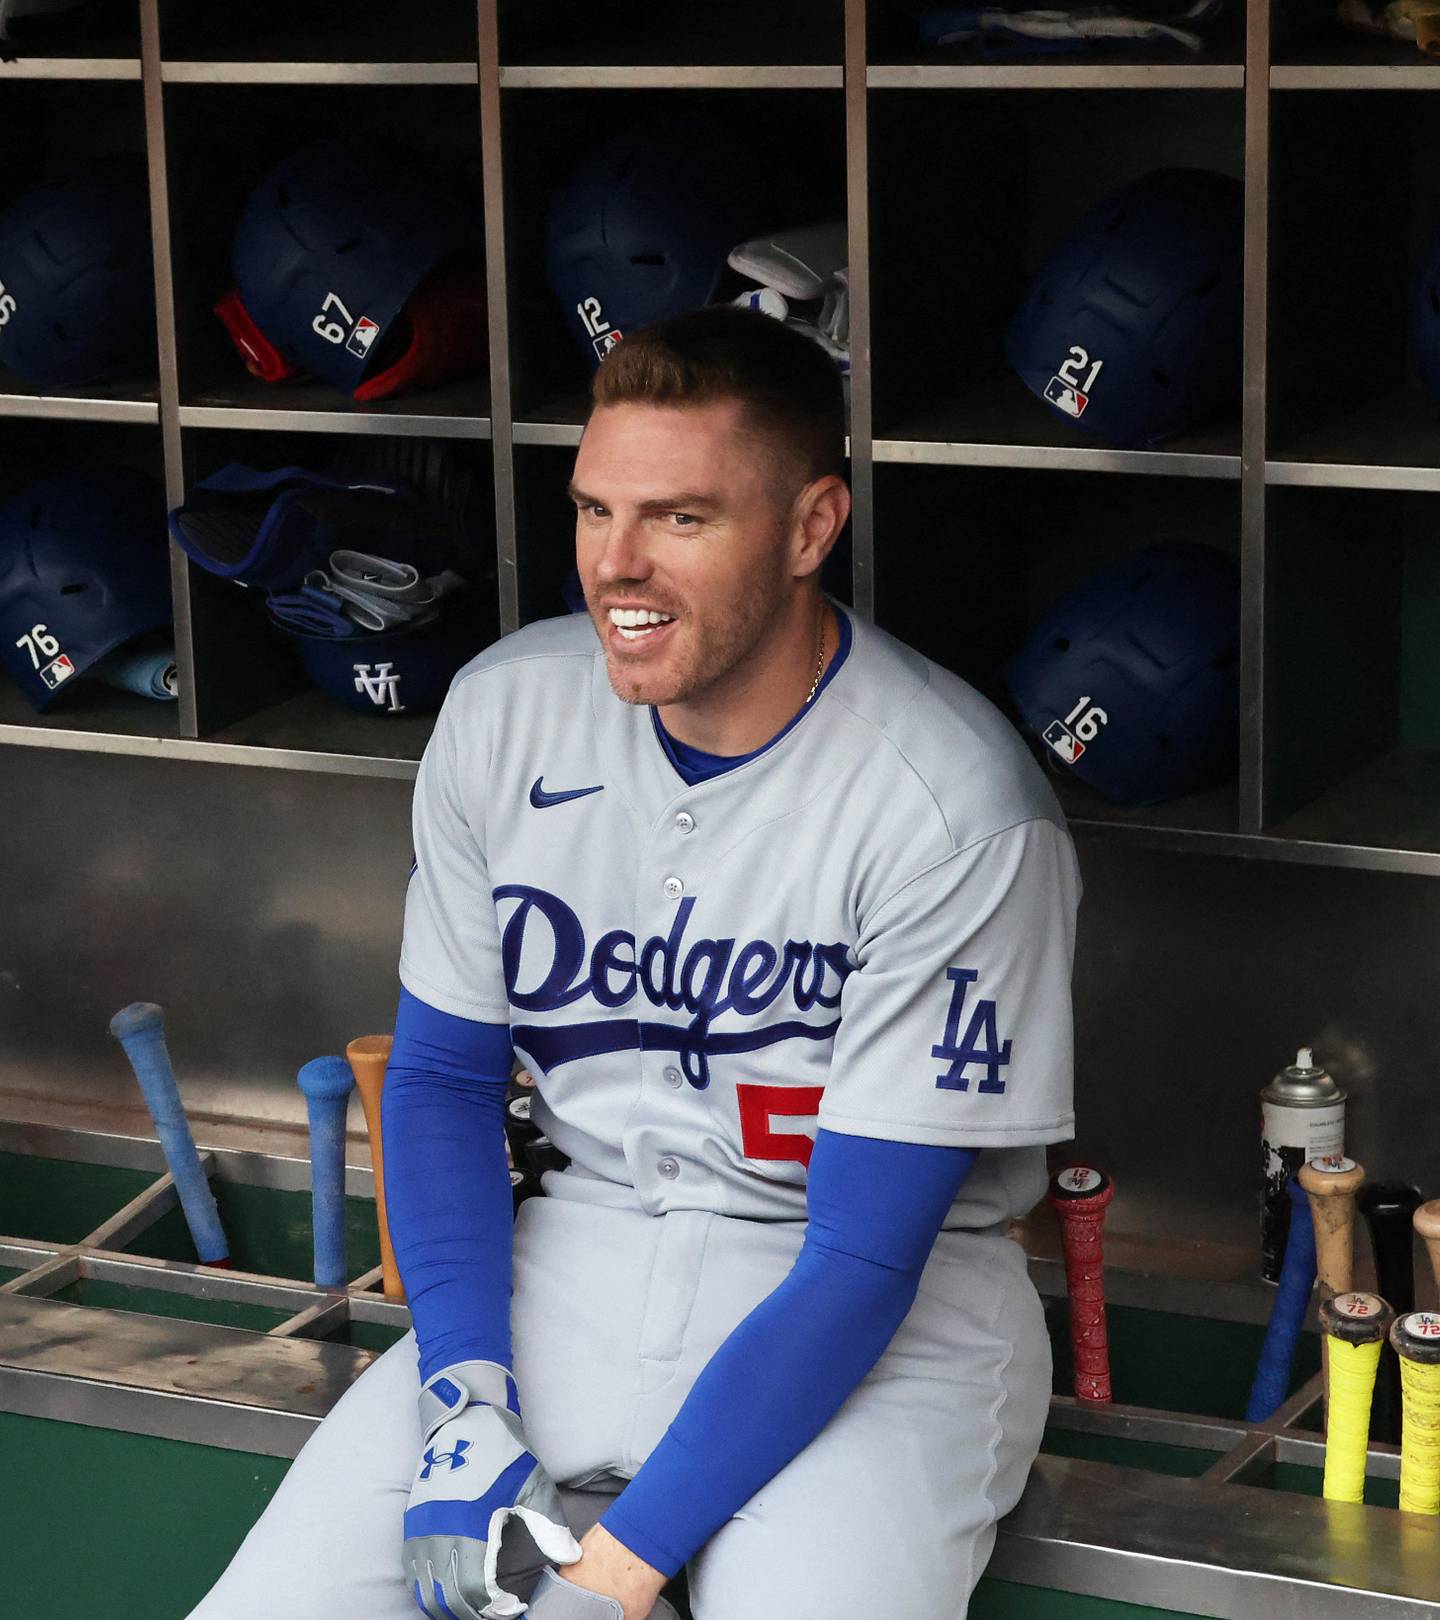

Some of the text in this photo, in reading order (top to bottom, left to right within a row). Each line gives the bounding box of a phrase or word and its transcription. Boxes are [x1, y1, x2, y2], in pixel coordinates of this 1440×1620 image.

[312, 292, 354, 344] 67
[577, 296, 610, 337] 12
[1058, 345, 1103, 393] 21
[15, 623, 60, 670] 76
[1064, 696, 1108, 741] 16
[492, 884, 860, 1090] Dodgers
[932, 967, 1012, 1094] LA
[736, 1083, 825, 1170] 5
[1346, 1303, 1370, 1315] 72
